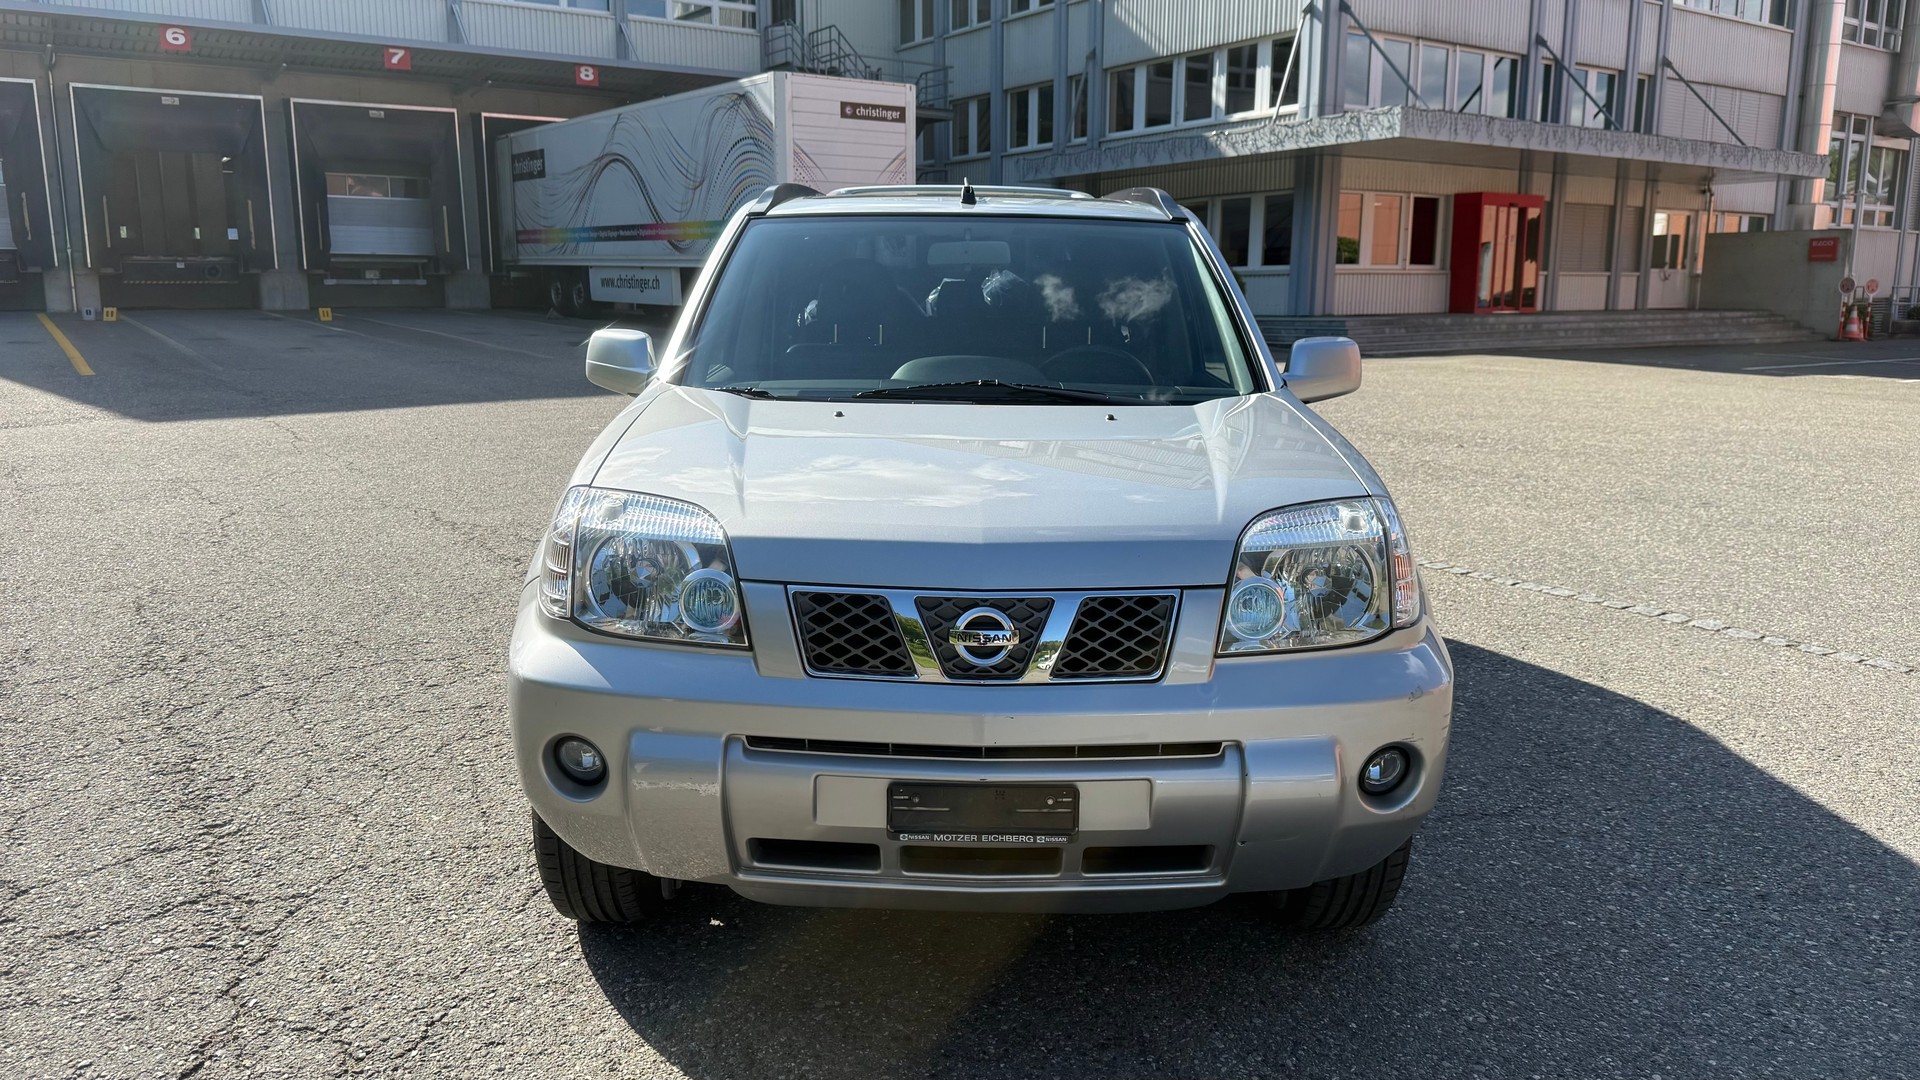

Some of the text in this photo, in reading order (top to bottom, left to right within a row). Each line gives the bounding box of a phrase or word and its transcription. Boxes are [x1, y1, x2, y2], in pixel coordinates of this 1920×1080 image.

[166, 27, 186, 45] 6
[389, 48, 405, 64] 7
[580, 66, 594, 81] 8
[856, 106, 900, 120] christinger
[601, 274, 660, 293] www.christinger.ch
[957, 633, 1012, 642] NISSAN
[934, 834, 977, 842] MOTZER
[982, 834, 1034, 843] EICHBERG
